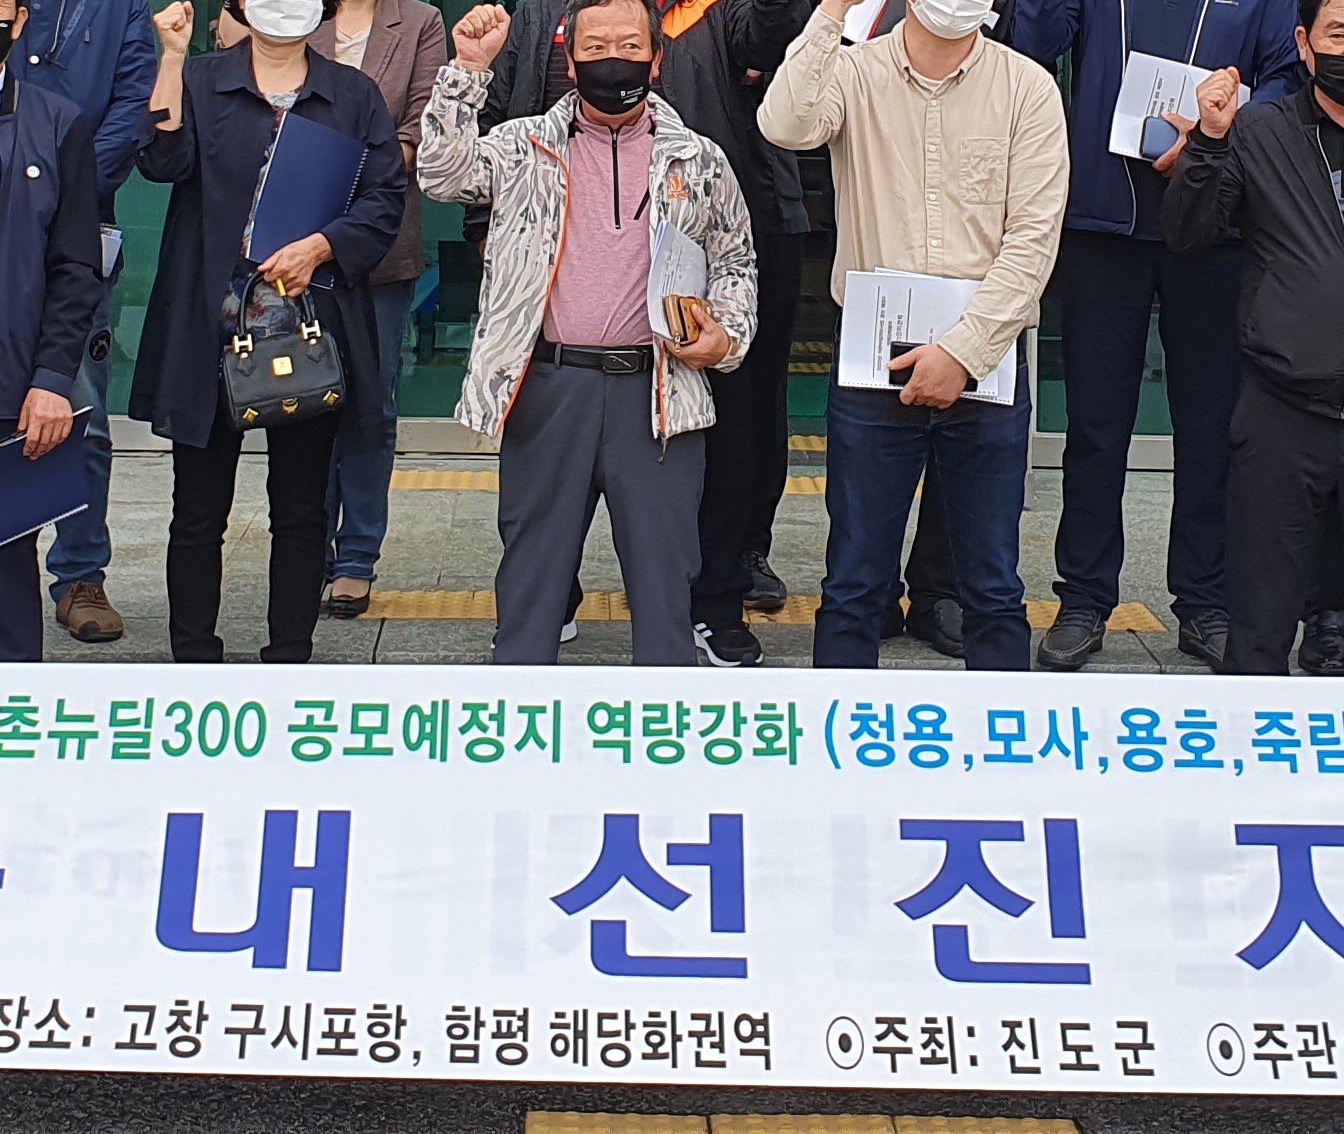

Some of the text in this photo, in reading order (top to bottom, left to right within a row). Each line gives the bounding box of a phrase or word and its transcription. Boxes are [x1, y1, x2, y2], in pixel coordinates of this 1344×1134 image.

[287, 698, 562, 763] 공모예정지
[587, 699, 804, 765] 역량강화
[113, 999, 210, 1059] 고창
[223, 1002, 423, 1068] 구시포항,
[445, 1005, 530, 1065] 함평
[549, 1010, 773, 1072] 해당화권역
